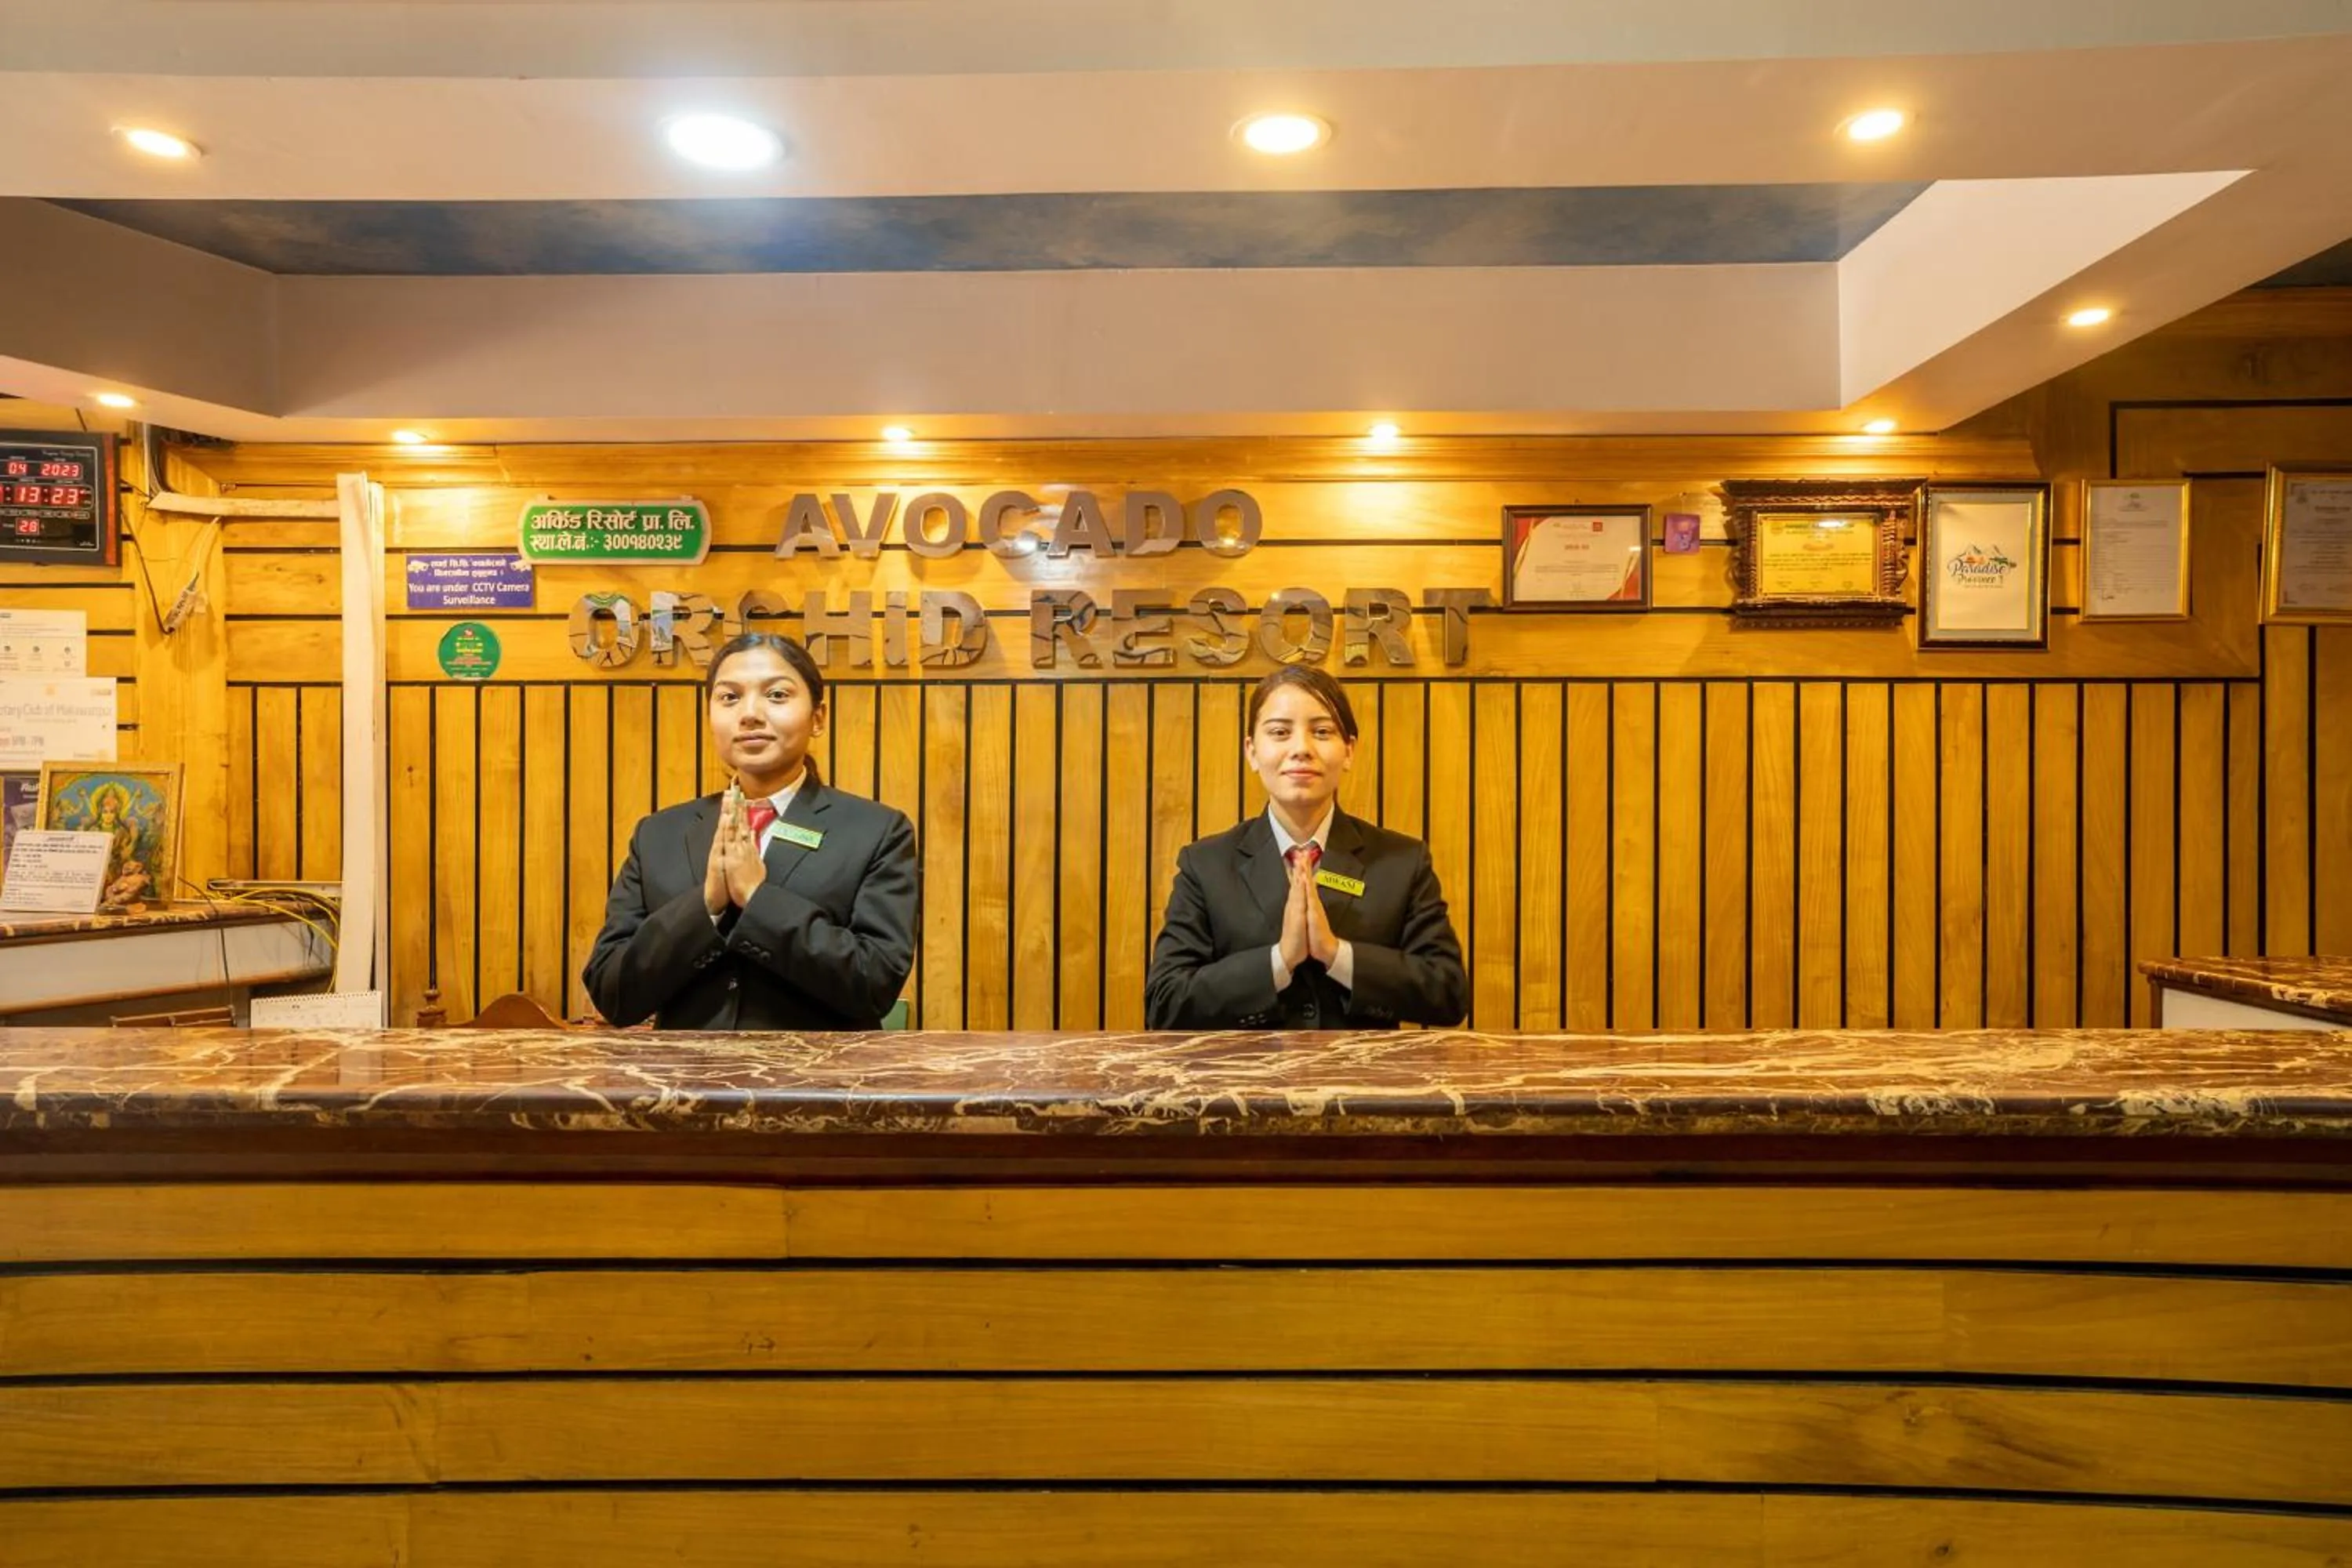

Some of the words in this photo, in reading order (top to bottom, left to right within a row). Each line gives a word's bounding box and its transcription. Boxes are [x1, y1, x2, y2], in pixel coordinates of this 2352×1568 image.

[9, 462, 27, 475] 04
[42, 463, 80, 477] 2023
[587, 509, 637, 532] रिसोर्ट
[642, 514, 664, 532] प्रा.
[668, 509, 695, 530] लि.
[775, 489, 1262, 559] AVOCADO
[408, 583, 424, 593] You
[426, 584, 441, 593] are
[442, 583, 468, 593] under
[473, 583, 495, 593] CCTV
[497, 583, 530, 593] Camera
[443, 595, 496, 605] Surveillance
[568, 590, 988, 668] ORCHID
[1029, 586, 1491, 668] RESORT
